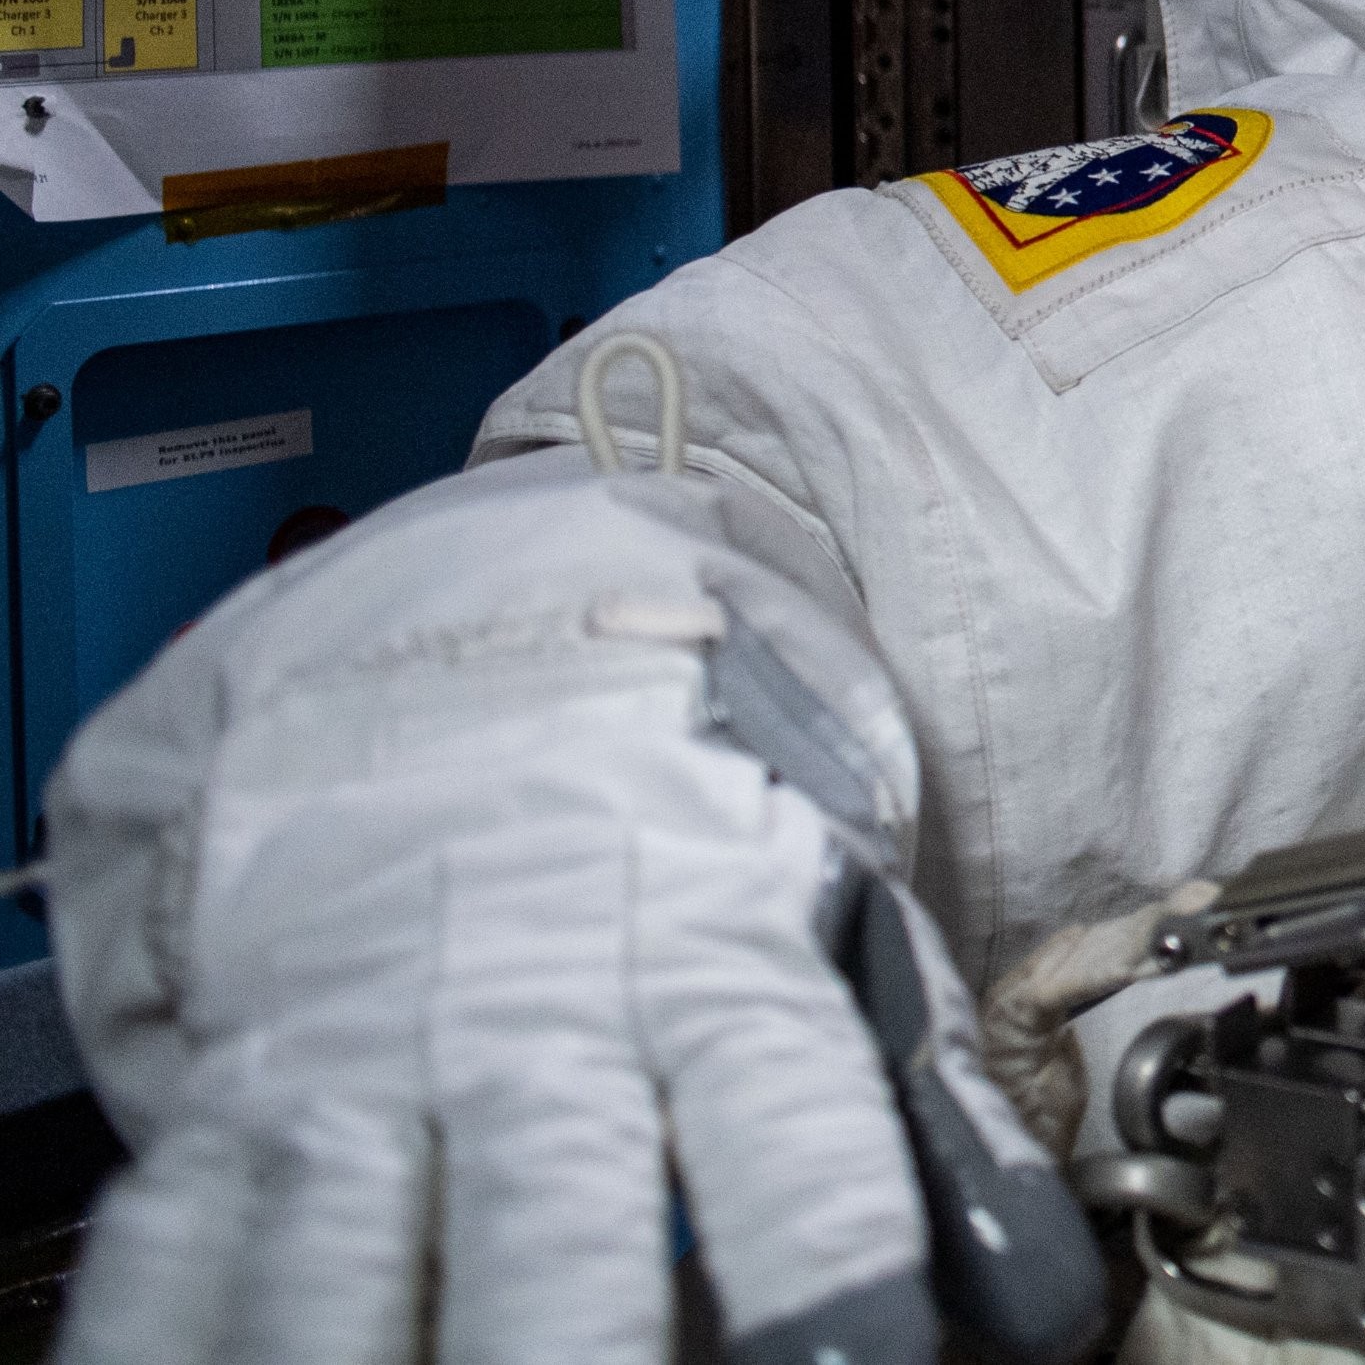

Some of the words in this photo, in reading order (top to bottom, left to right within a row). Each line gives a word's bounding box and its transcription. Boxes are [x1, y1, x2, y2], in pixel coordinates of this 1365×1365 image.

[135, 10, 177, 23] Charger
[10, 26, 26, 36] Ch
[29, 26, 36, 35] 1
[150, 26, 164, 36] Ch
[168, 26, 174, 36] 2
